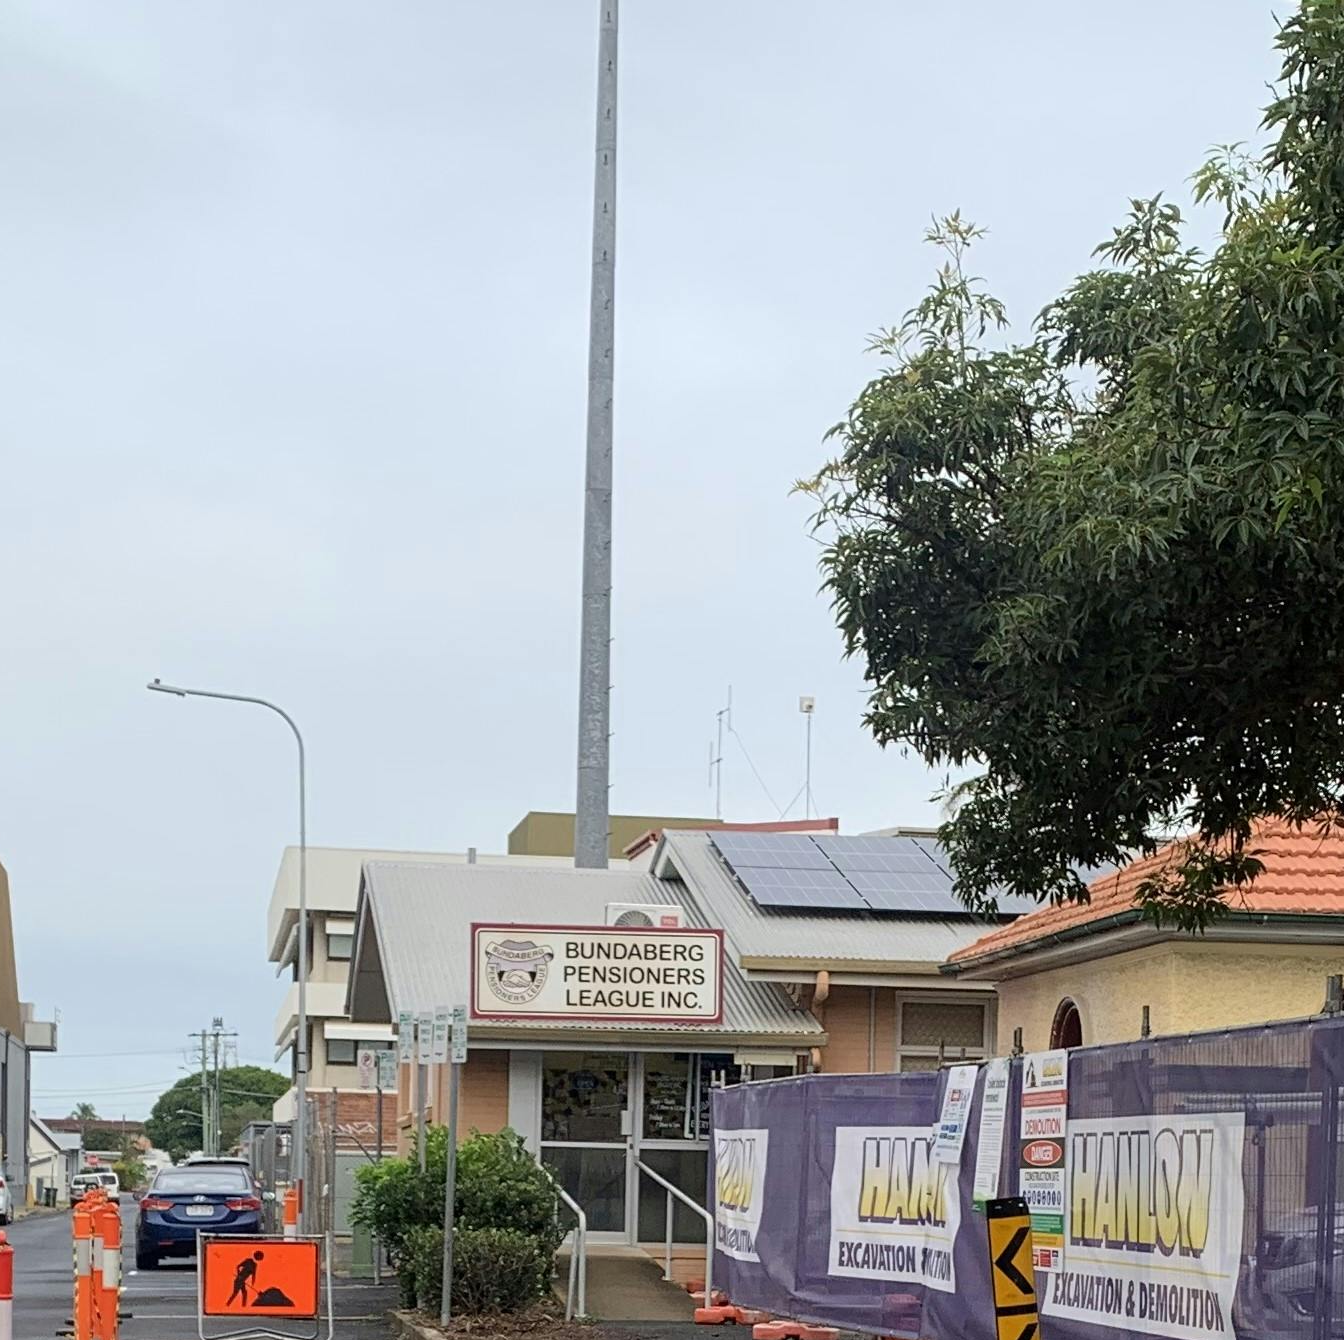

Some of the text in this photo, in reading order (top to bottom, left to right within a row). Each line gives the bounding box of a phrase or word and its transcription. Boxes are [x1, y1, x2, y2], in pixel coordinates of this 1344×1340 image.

[492, 946, 545, 959] BUNDABERG
[565, 942, 704, 961] BUNDABERG
[527, 968, 546, 997] LEAGUE
[564, 966, 705, 985] PENSIONERS
[566, 989, 702, 1009] LEAGUE INC.
[1070, 1127, 1214, 1259] HANLON
[838, 1241, 916, 1273] EXCAVATION
[1052, 1271, 1224, 1332] EXCAVATION & DEMOLITION
